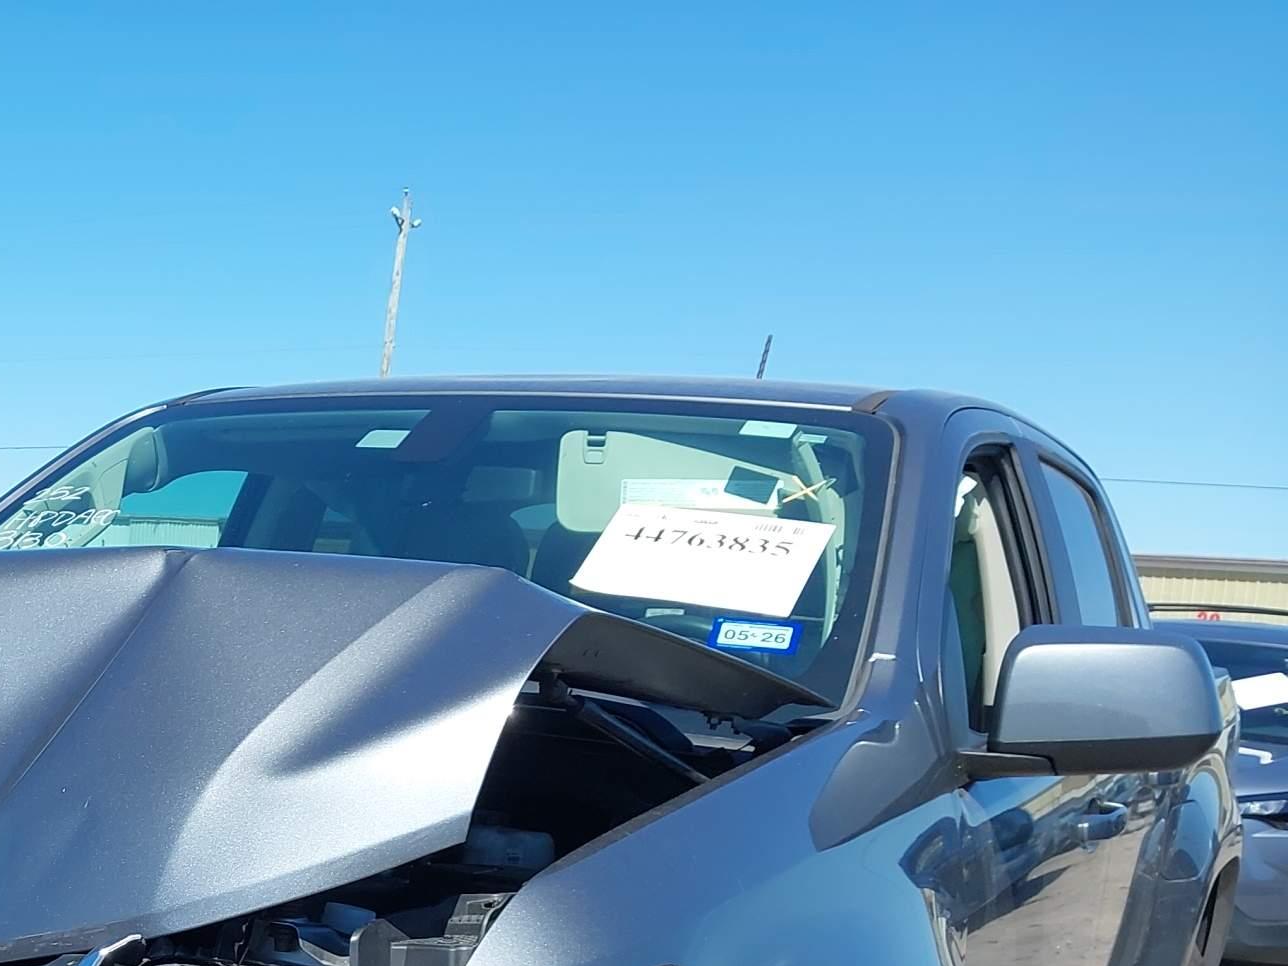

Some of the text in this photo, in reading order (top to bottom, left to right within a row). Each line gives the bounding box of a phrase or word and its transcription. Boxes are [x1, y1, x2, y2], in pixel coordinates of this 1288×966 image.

[624, 526, 794, 557] 44763835
[724, 629, 787, 644] 05 26
